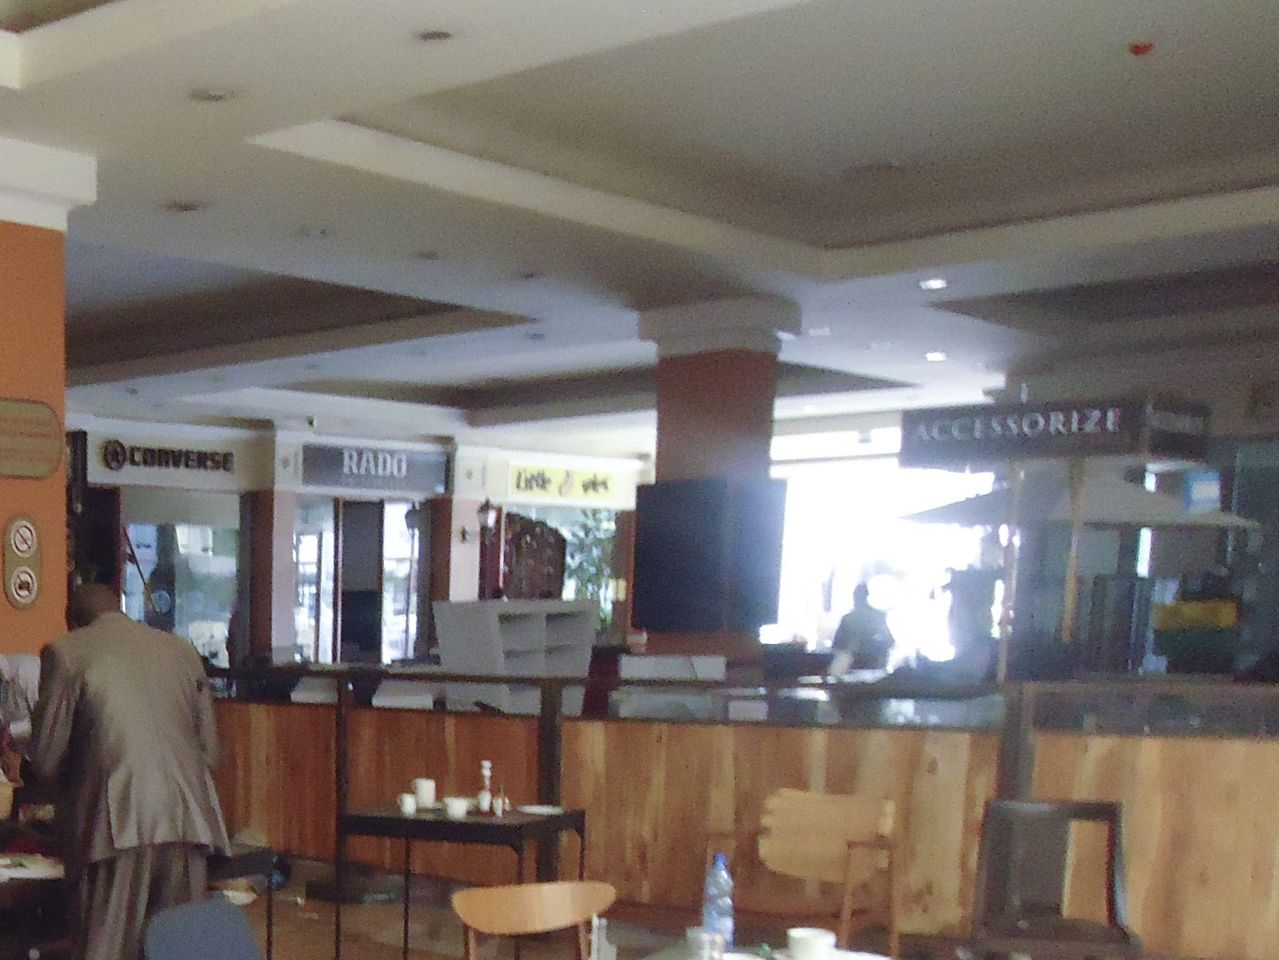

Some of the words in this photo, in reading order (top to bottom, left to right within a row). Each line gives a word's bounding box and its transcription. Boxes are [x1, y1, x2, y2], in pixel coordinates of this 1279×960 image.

[918, 407, 1120, 441] ACCESSORIZE
[129, 446, 234, 472] CONVERSE
[343, 449, 407, 478] RADO
